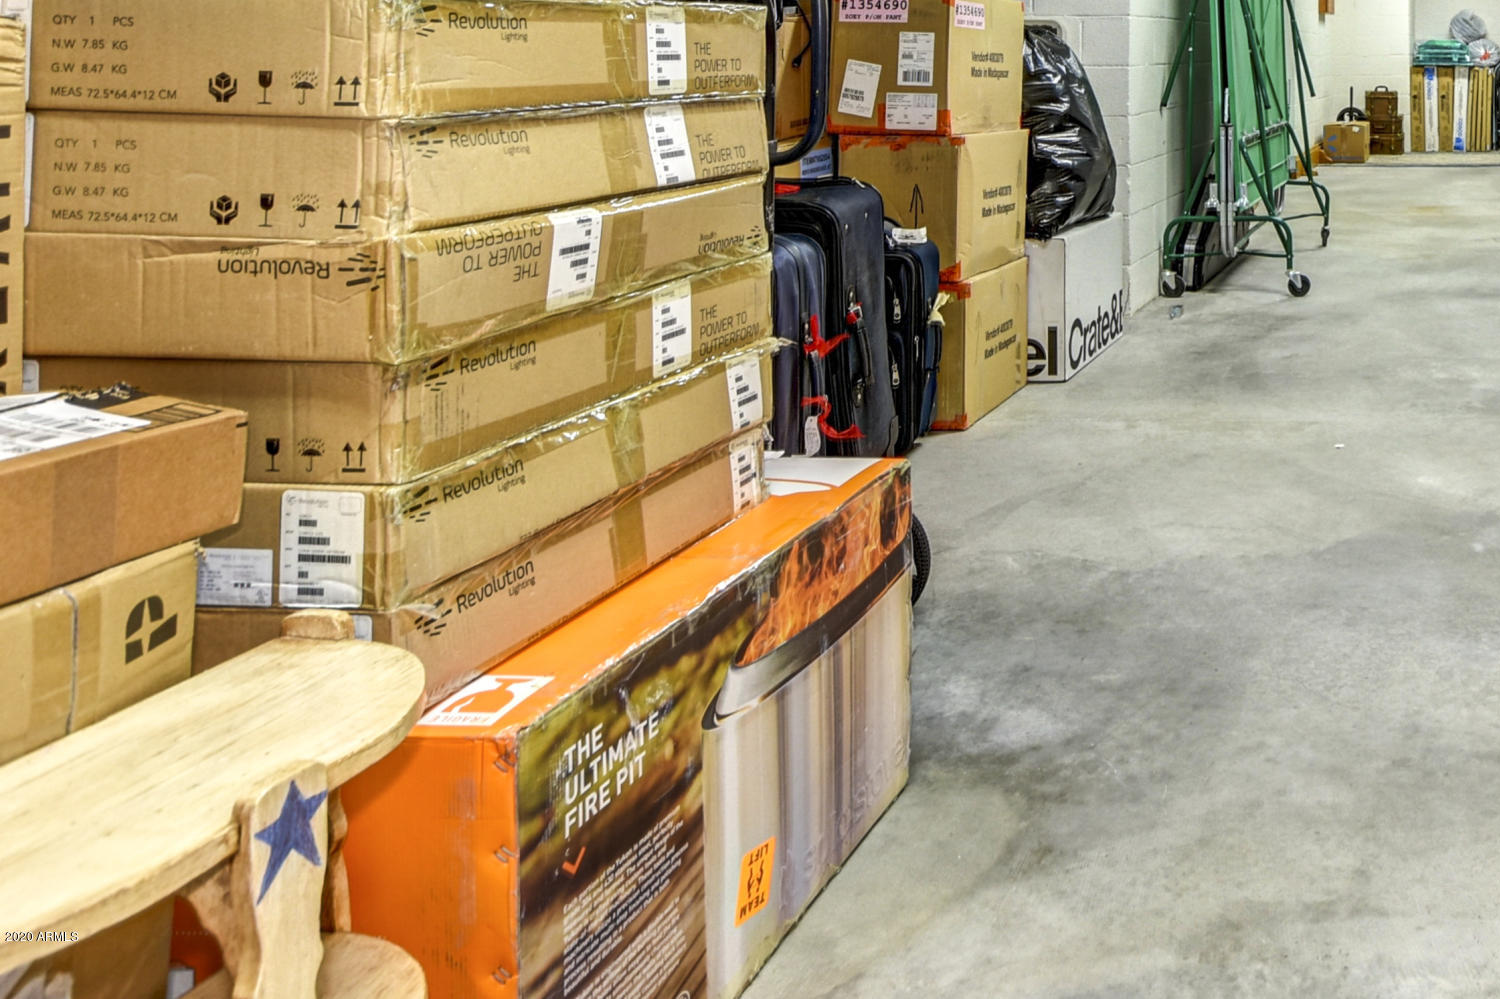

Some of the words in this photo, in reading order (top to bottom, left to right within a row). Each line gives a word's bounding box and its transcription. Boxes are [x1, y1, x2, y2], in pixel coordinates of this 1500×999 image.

[53, 15, 77, 26] QTY
[90, 16, 94, 26] 1
[112, 16, 134, 27] PCS
[448, 12, 527, 31] Revolution
[82, 39, 105, 50] 7.85
[112, 41, 128, 51] KG
[500, 30, 528, 43] Lighting
[694, 42, 711, 56] THE
[81, 63, 104, 74] 8.47
[111, 65, 128, 74] KG
[694, 58, 727, 73] POWER
[729, 58, 742, 71] TO
[50, 87, 82, 98] MEAS
[158, 89, 177, 100] CM
[54, 138, 78, 149] QTY
[92, 139, 97, 149] 1
[115, 140, 137, 150] PCS
[449, 128, 528, 148] Revolution
[696, 134, 714, 148] THE
[699, 148, 731, 163] POWER
[733, 145, 746, 160] TO
[84, 162, 107, 173] 7.85
[114, 163, 130, 173] KG
[82, 186, 105, 197] 8.47
[112, 187, 129, 197] KG
[51, 209, 83, 221] MEAS
[159, 212, 178, 222] CM
[487, 241, 542, 266] POWER
[218, 259, 330, 280] Revolution
[462, 255, 484, 273] TO
[513, 266, 540, 283] THE
[700, 304, 718, 321] THE
[700, 316, 734, 338] POWER
[736, 311, 748, 326] TO
[700, 324, 760, 356] OUTPERFORM
[460, 340, 536, 375] Revolution
[509, 354, 536, 371] Lighting
[442, 456, 524, 503] Revolution
[497, 473, 526, 493] Lighting
[456, 560, 535, 614] Revolution
[508, 575, 536, 597] Lighting
[564, 722, 604, 773] THE
[565, 711, 659, 805] ULTIMATE
[565, 780, 611, 839] FIRE
[616, 751, 646, 796] PIT
[748, 843, 770, 866] LIFT
[740, 892, 765, 920] TEAM
